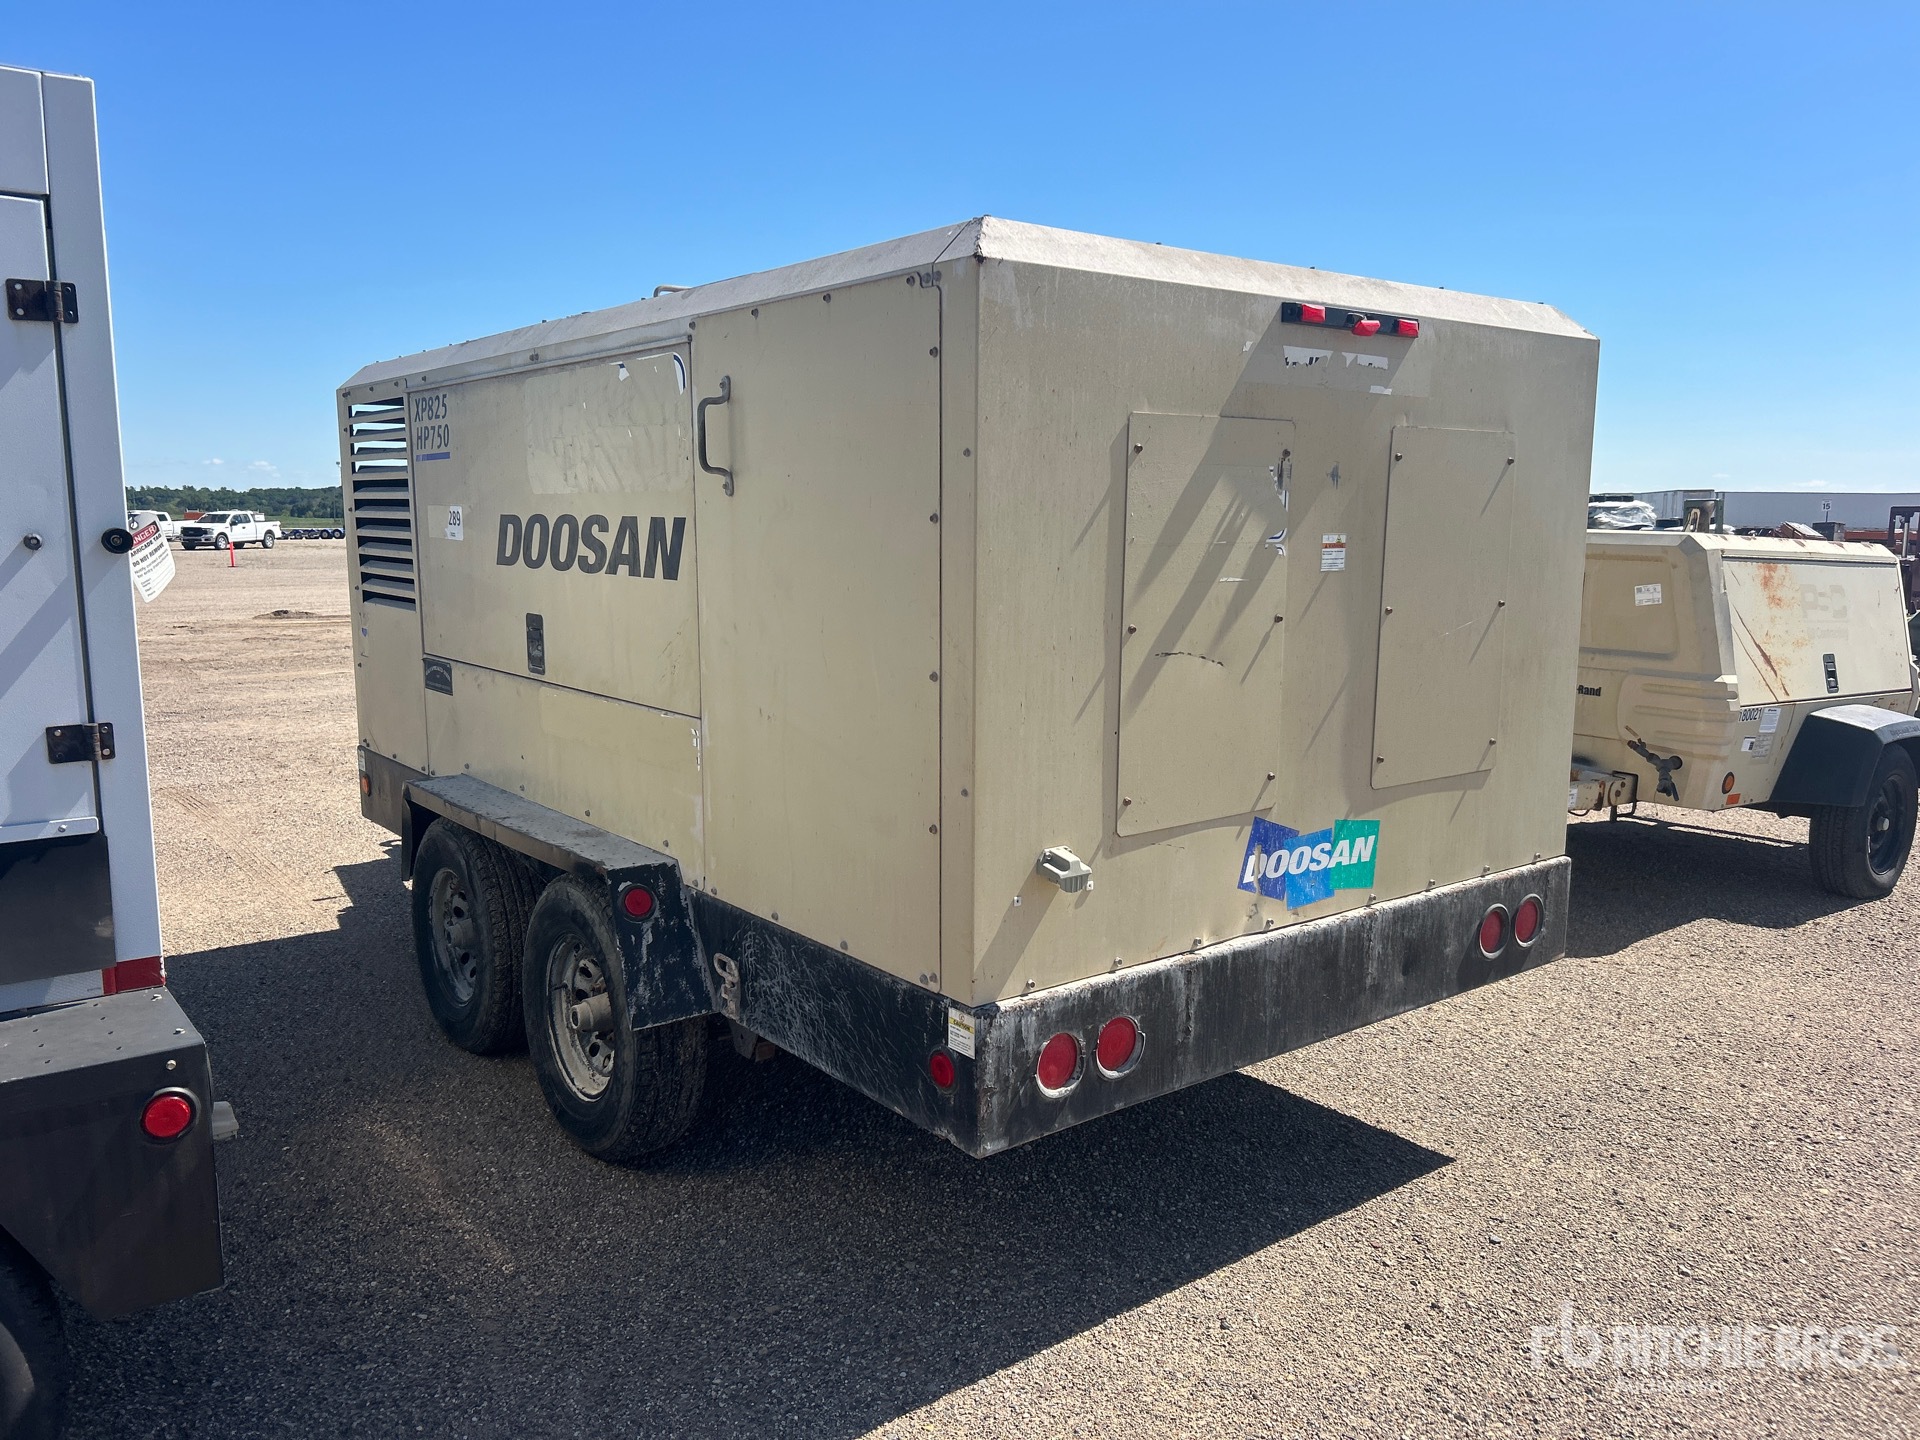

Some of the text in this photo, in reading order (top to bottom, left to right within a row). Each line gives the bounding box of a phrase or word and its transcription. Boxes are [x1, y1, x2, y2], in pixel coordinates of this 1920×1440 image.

[414, 393, 447, 422] XP825
[416, 423, 449, 450] HP750
[1823, 502, 1830, 510] 15
[133, 524, 156, 544] ANGER
[496, 513, 686, 581] DOOSAN
[131, 540, 153, 557] ARRICADE
[132, 542, 164, 568] DO NOT REMOVE
[1242, 834, 1376, 884] DOOSAN
